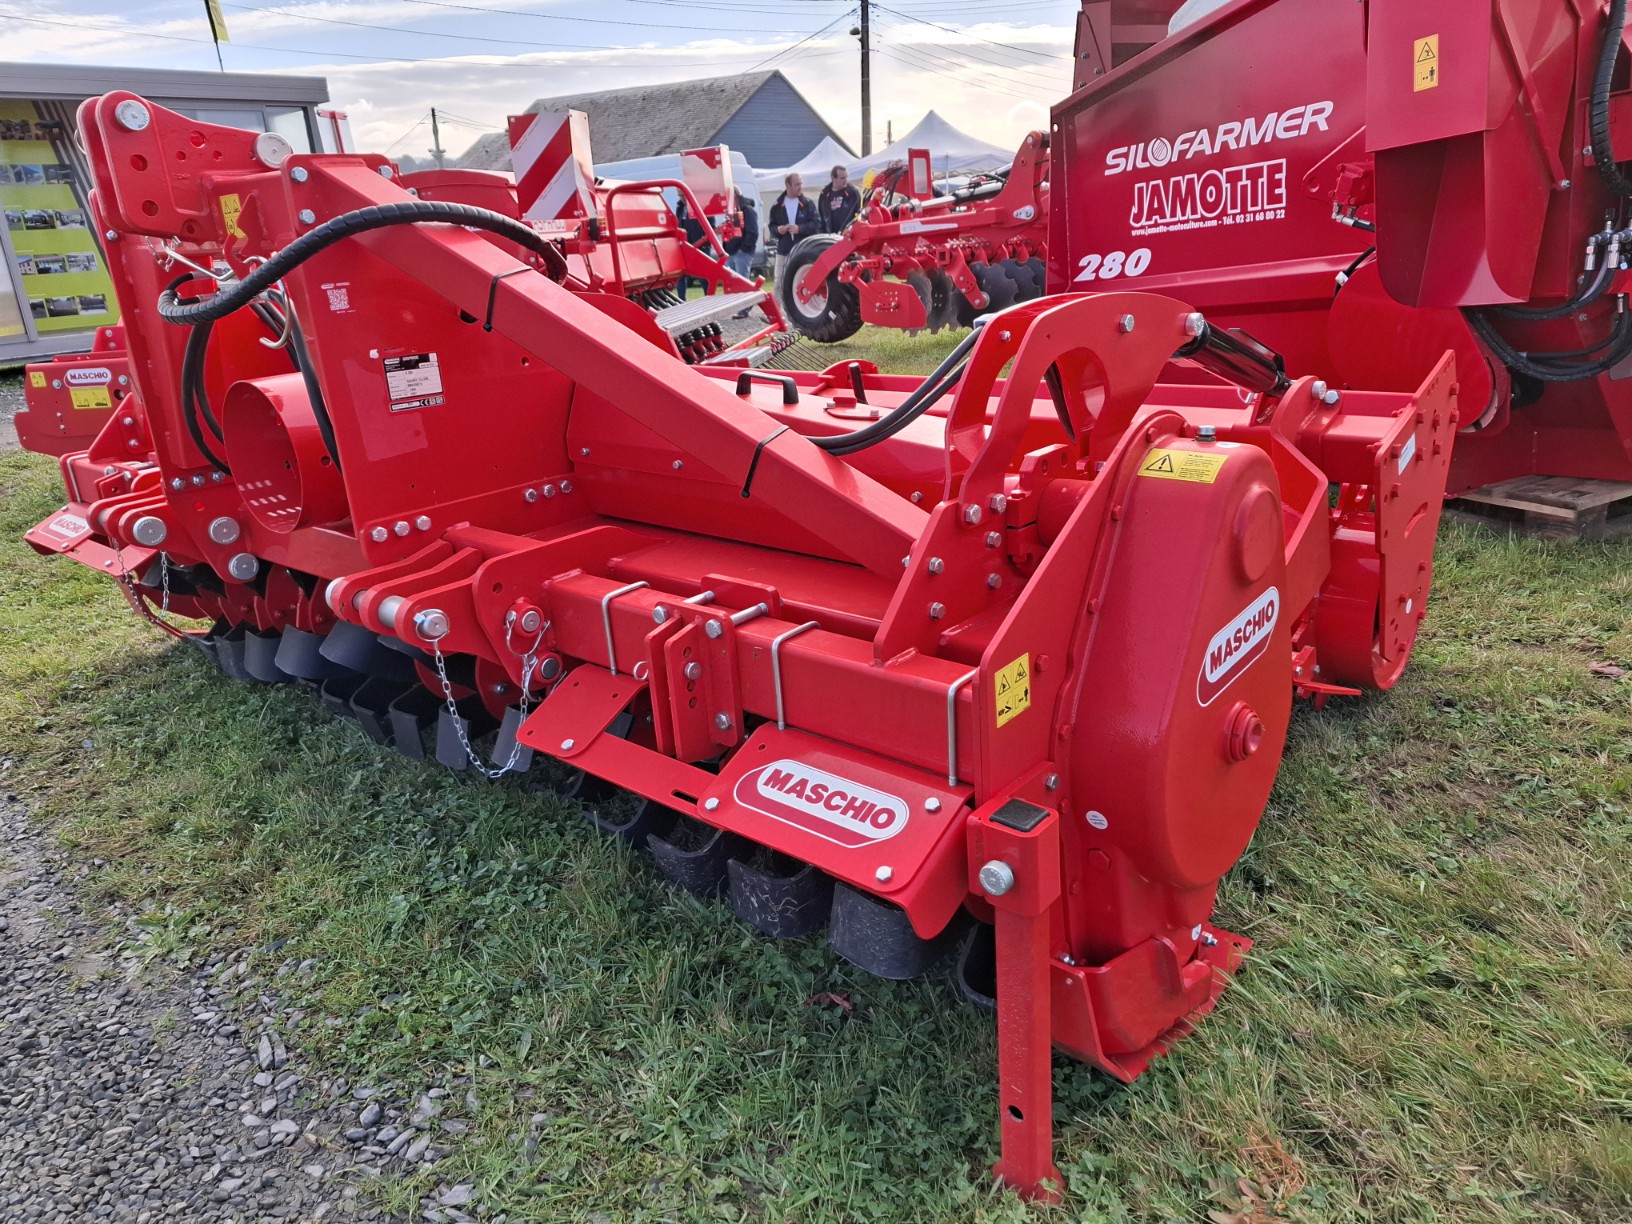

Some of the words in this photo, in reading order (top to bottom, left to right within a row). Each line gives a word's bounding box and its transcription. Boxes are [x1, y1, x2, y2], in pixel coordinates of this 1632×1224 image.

[1104, 100, 1334, 176] SILOFARMER
[1130, 158, 1286, 227] JAMOTTE
[1131, 219, 1218, 236] www.jamotte-motoculture.com
[1236, 214, 1244, 224] 02
[1245, 213, 1254, 223] 31
[1255, 211, 1265, 221] 68
[1265, 210, 1275, 220] 80
[1275, 209, 1285, 219] 22
[1073, 248, 1152, 281] 280
[69, 371, 109, 381] MASCHIO
[1209, 599, 1275, 675] MASCHIO
[763, 768, 897, 830] MASCHIO
